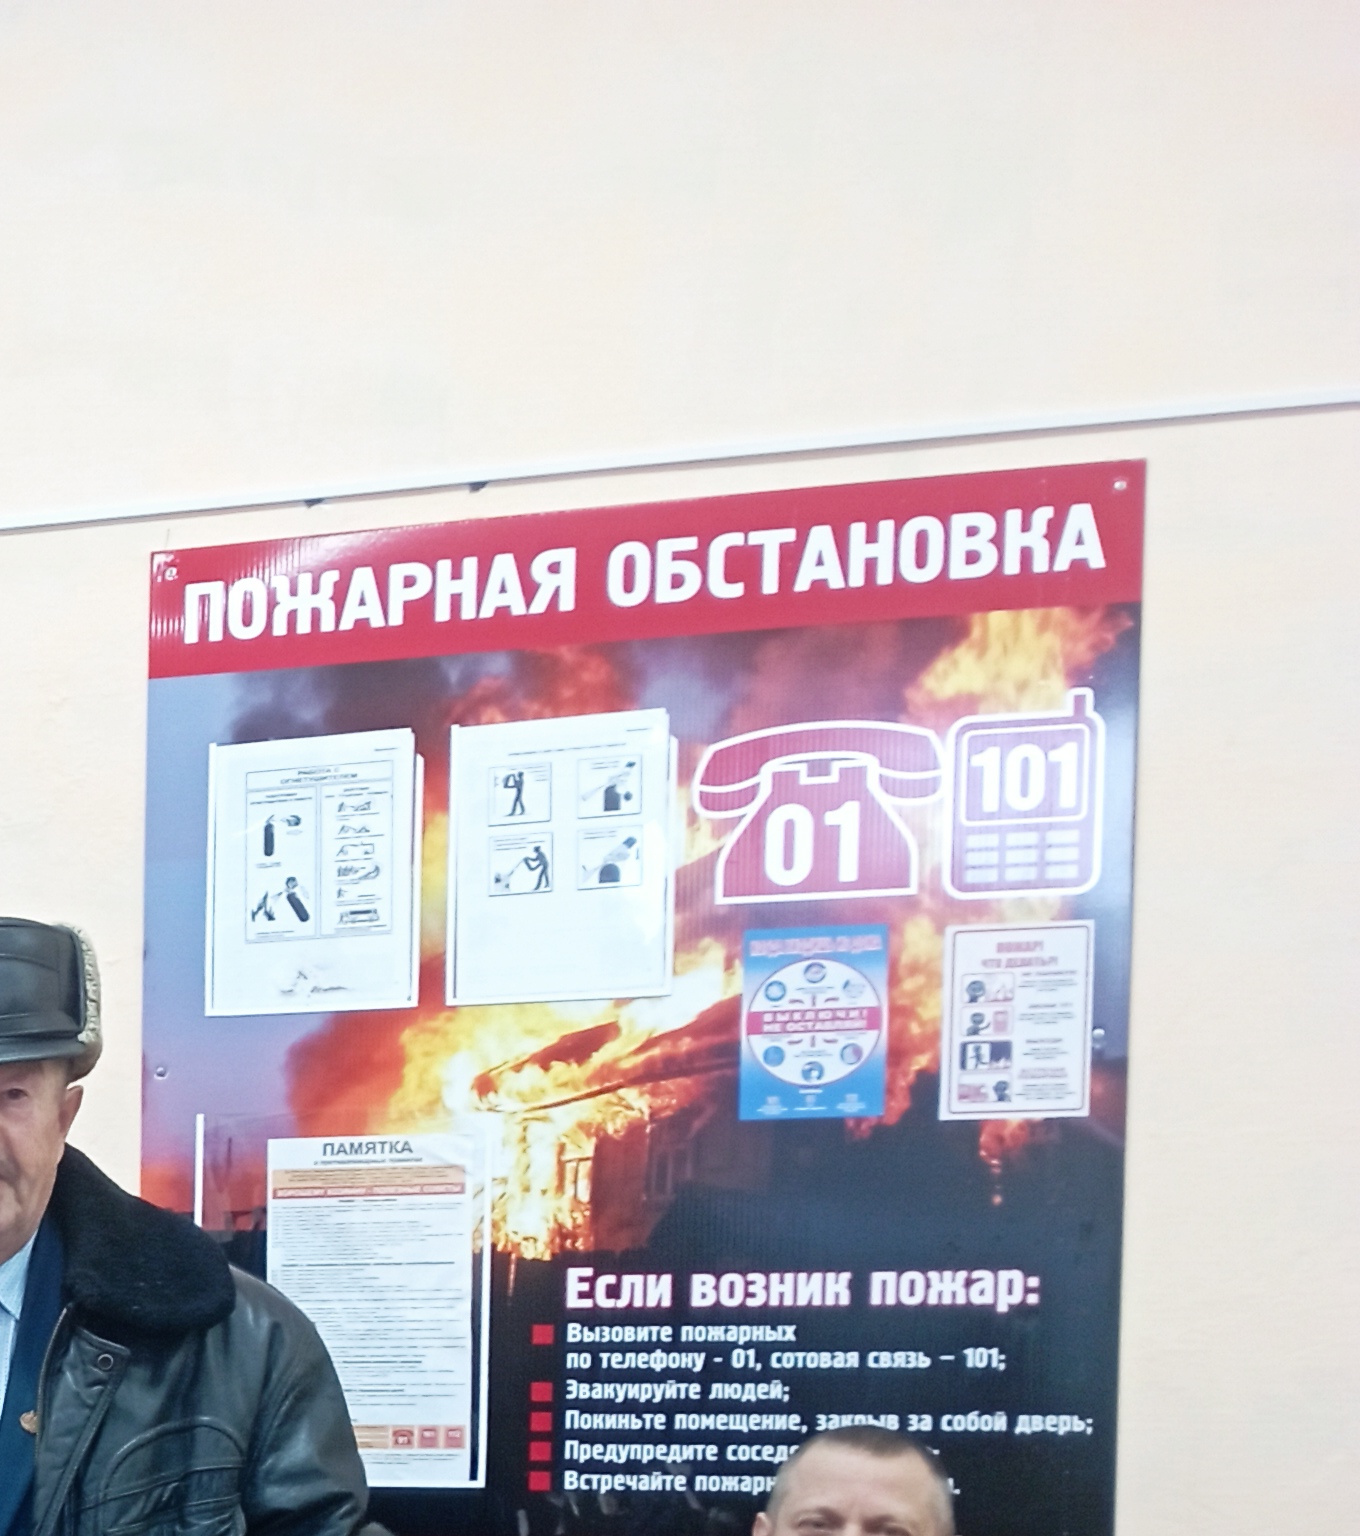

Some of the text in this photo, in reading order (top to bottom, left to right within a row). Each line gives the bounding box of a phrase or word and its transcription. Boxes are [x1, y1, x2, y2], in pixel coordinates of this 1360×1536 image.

[183, 502, 1106, 644] ПОЖАРНАЯ ОБСТАНОВКА
[971, 741, 1079, 813] 101
[764, 800, 861, 887] 01
[321, 1139, 414, 1157] ПАМЯТКА
[565, 1266, 1041, 1314] Если возник пожар:
[566, 1323, 798, 1346] Вызовите пожарных
[566, 1352, 592, 1369] по
[598, 1348, 706, 1373] телефону
[731, 1349, 763, 1372] 01,
[769, 1350, 860, 1370] сотовая
[866, 1351, 932, 1370] связь
[963, 1346, 1007, 1372] 101;
[565, 1378, 791, 1403] Эвакуируйте людей;
[565, 1409, 667, 1431] Покиньте
[673, 1411, 809, 1434] помещение,
[906, 1414, 933, 1432] за
[940, 1411, 1009, 1433] собой
[1014, 1414, 1094, 1436] дверь;
[564, 1440, 718, 1464] Предупредите
[564, 1470, 687, 1494] Встречайте
